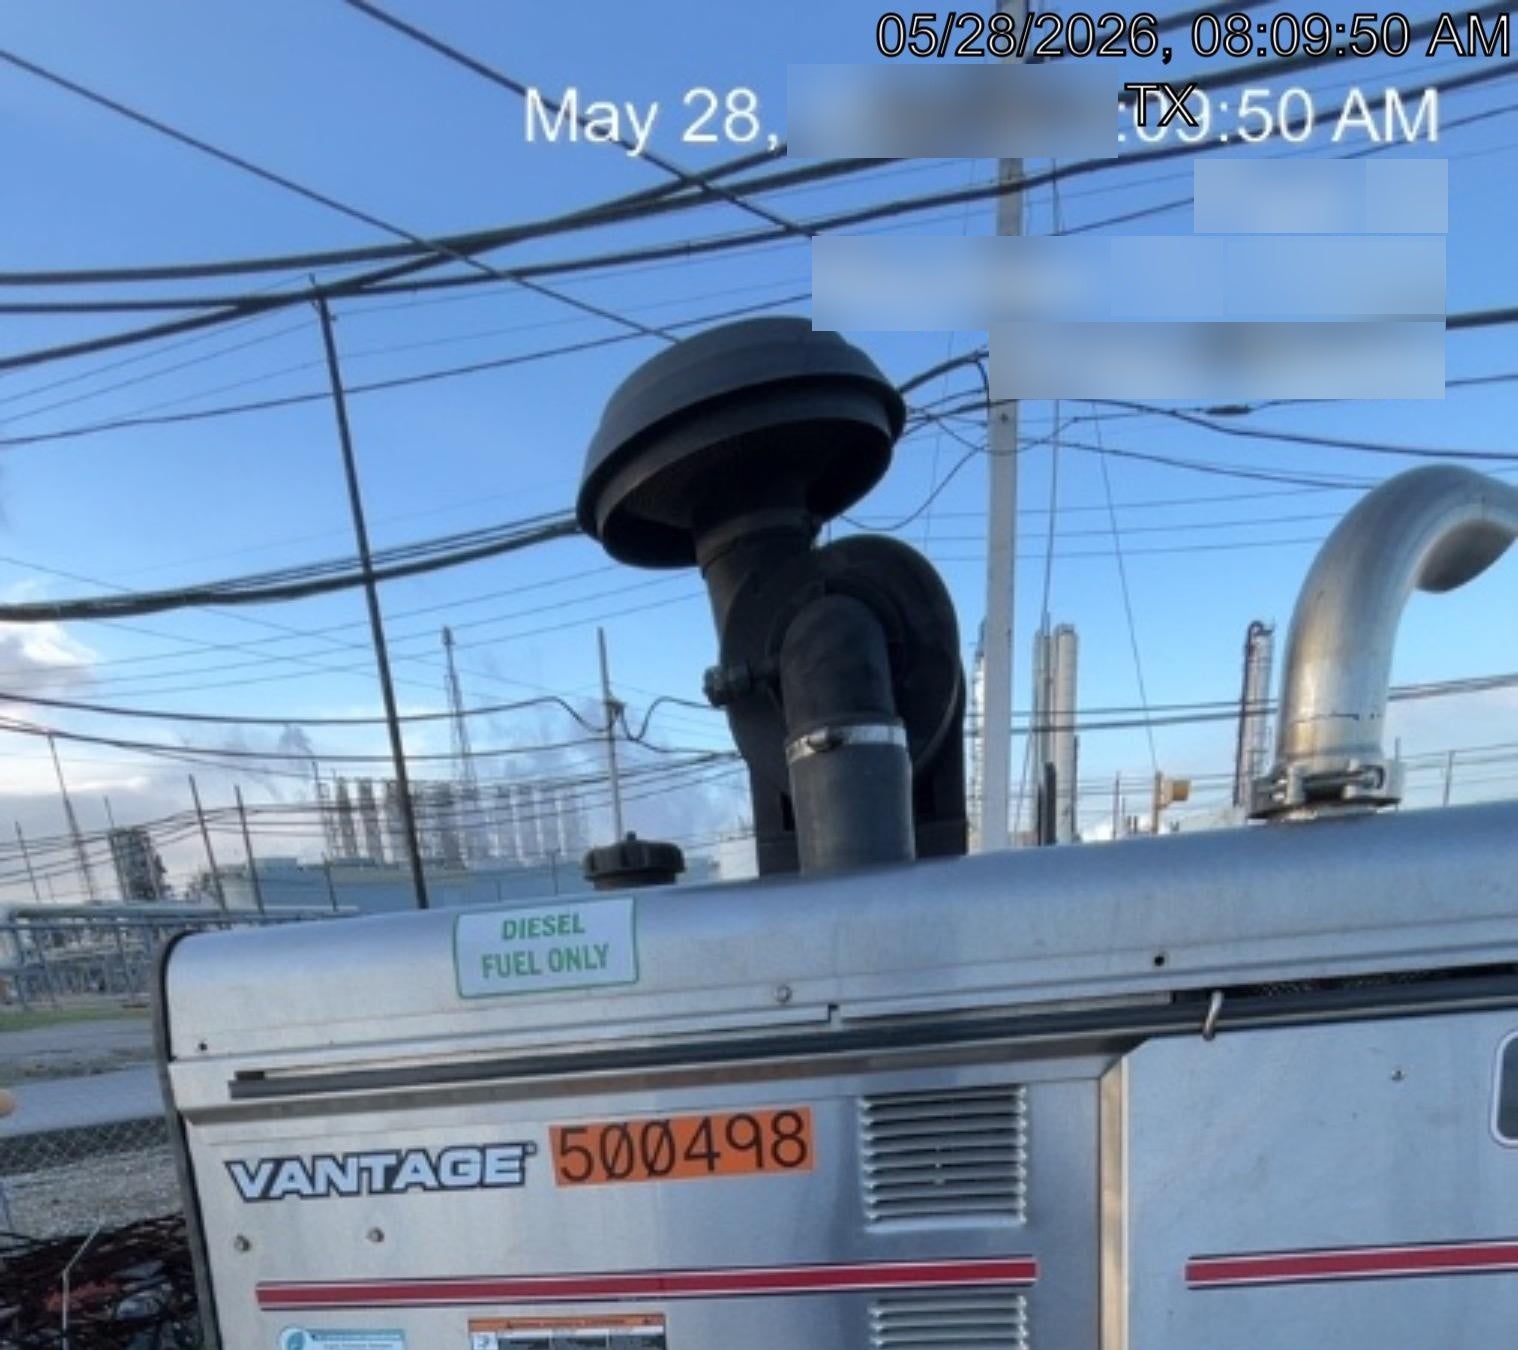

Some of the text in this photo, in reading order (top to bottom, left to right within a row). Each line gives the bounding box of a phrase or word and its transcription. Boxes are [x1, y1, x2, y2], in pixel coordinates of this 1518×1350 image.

[502, 913, 585, 941] DIESEL
[481, 943, 610, 979] FUEL ONLY
[560, 1110, 808, 1182] 500498
